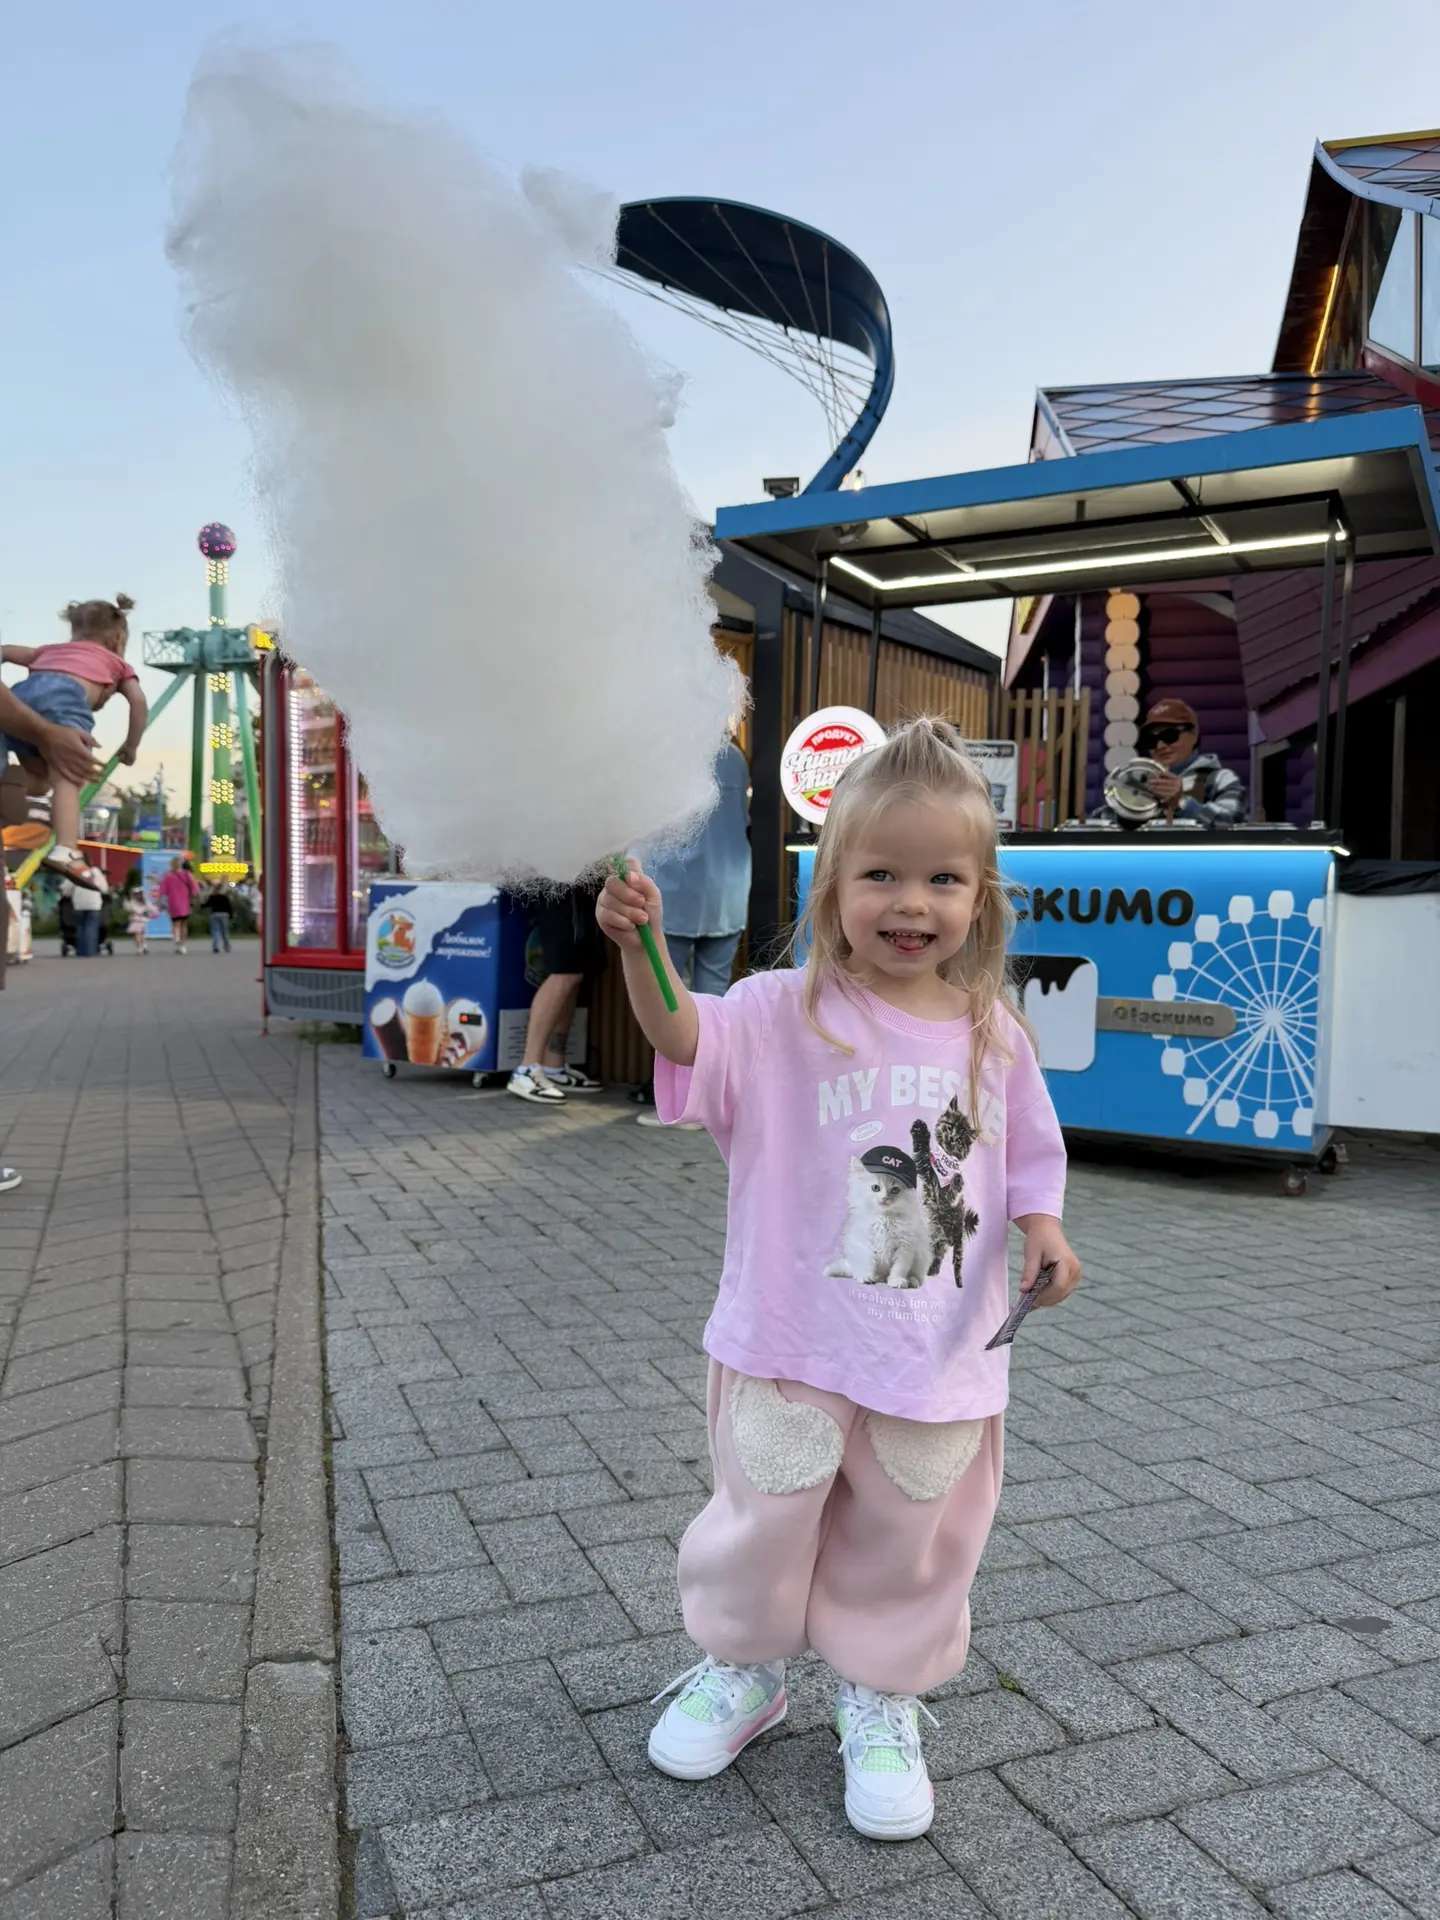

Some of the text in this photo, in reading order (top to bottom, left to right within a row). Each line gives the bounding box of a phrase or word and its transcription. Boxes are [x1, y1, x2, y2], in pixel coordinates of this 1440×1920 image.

[811, 728, 859, 746] ПРОДУКТ
[818, 1064, 1006, 1147] MY BESIE
[881, 1155, 903, 1168] CAT
[869, 1291, 907, 1308] always
[909, 1296, 928, 1309] fun
[867, 1306, 884, 1320] my
